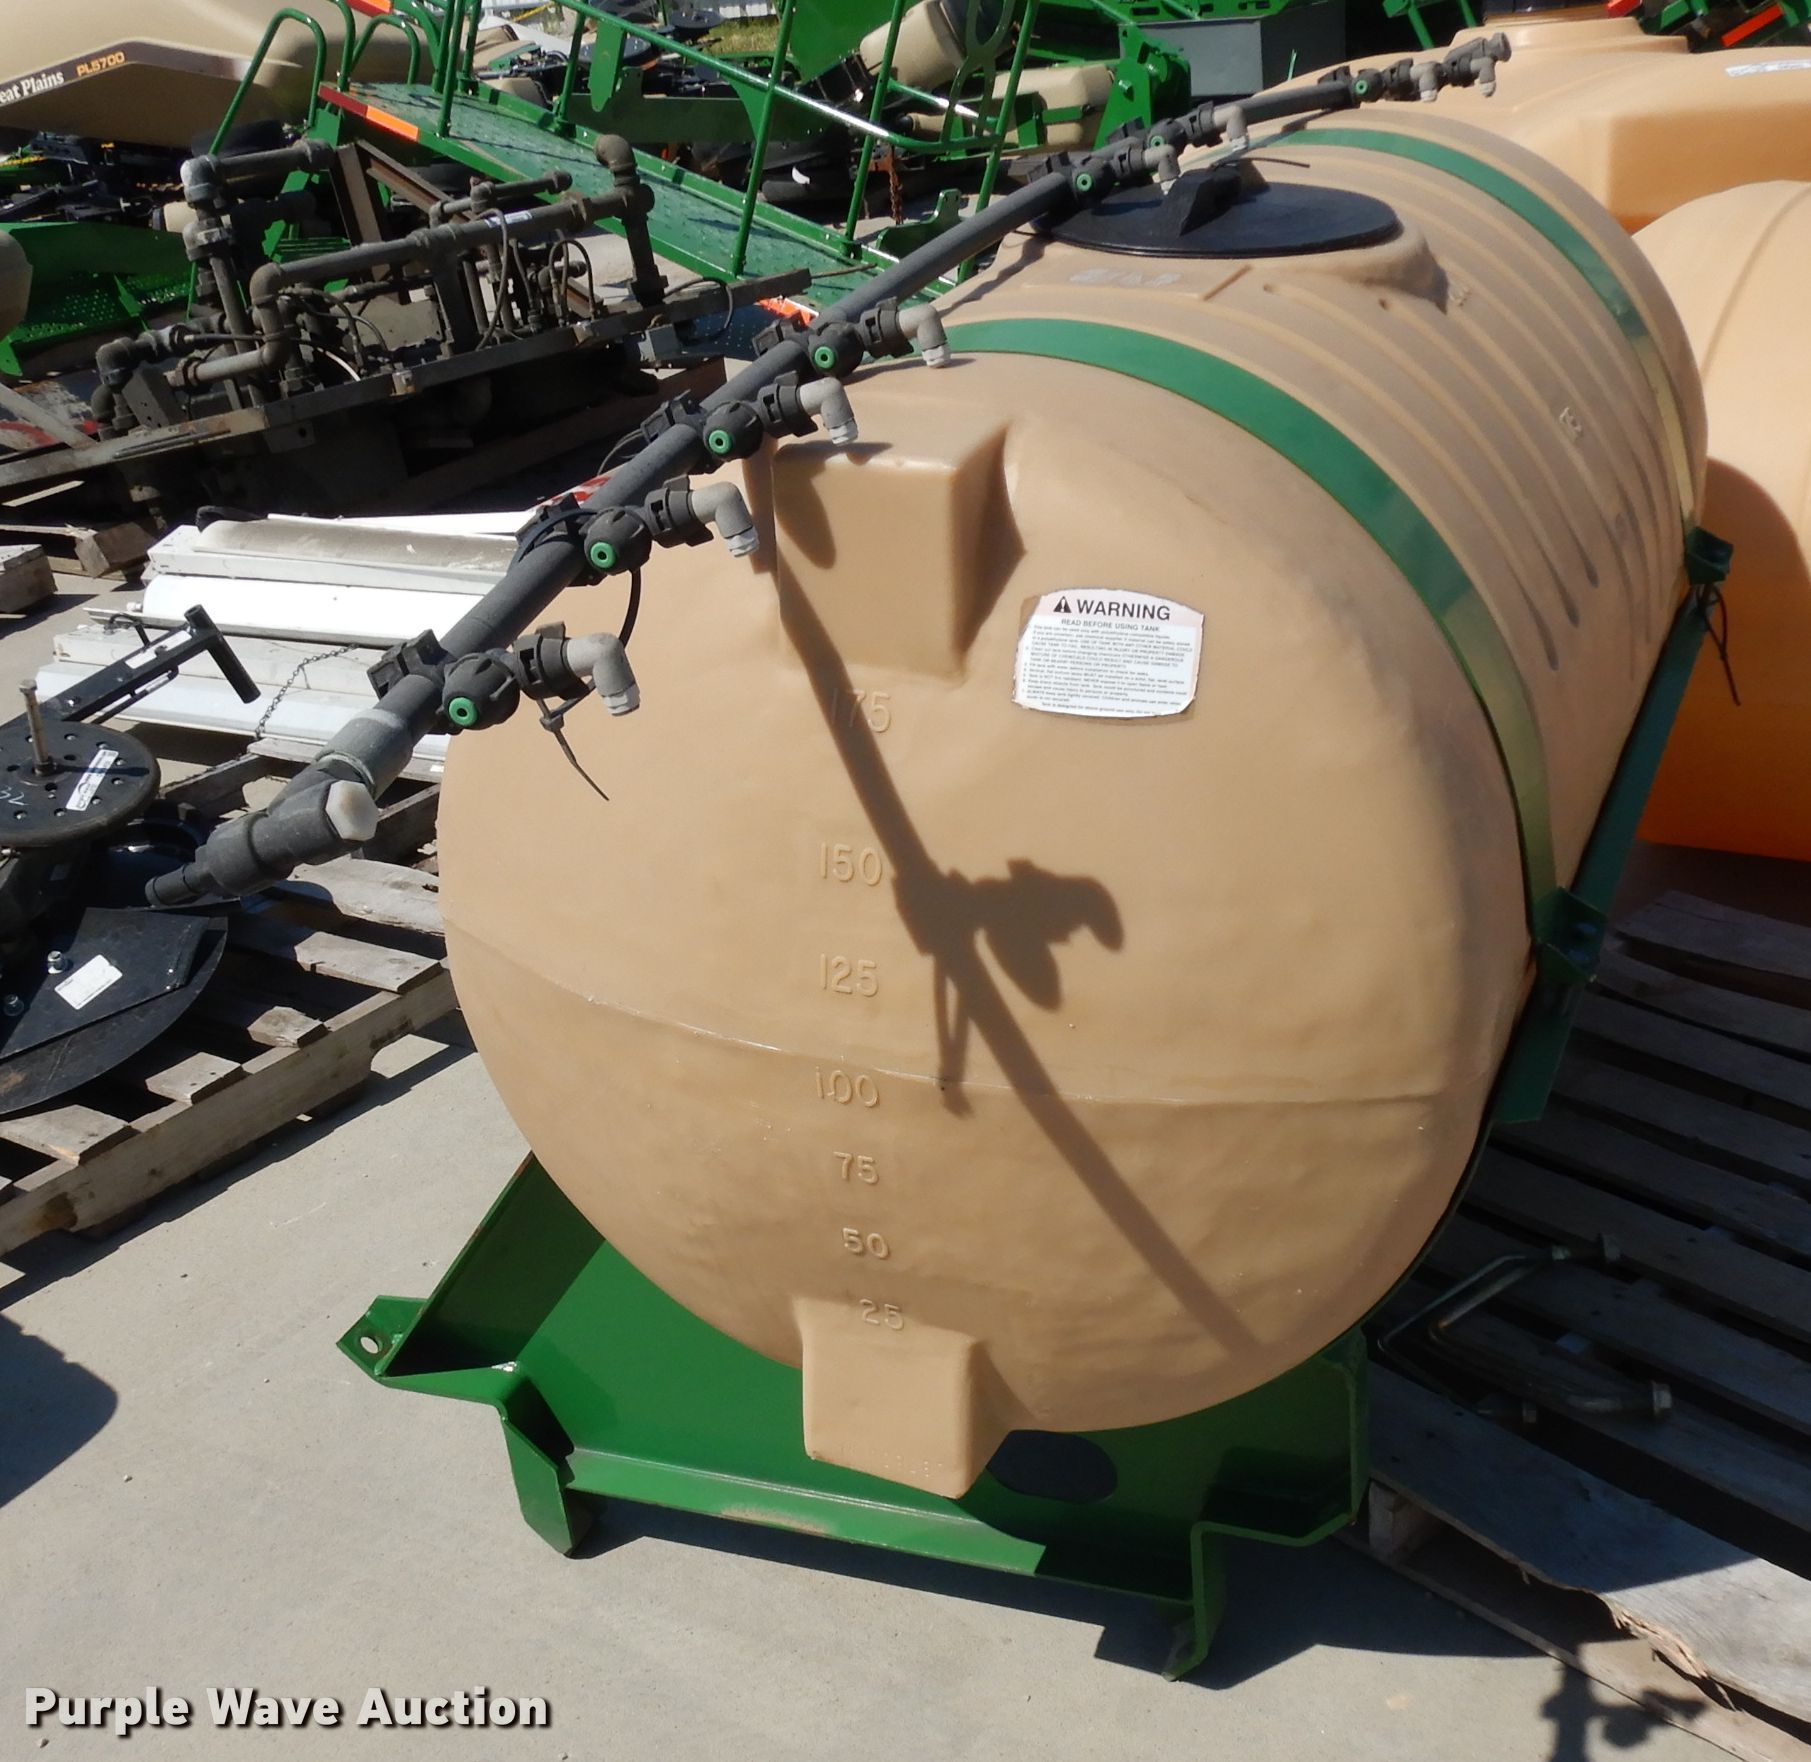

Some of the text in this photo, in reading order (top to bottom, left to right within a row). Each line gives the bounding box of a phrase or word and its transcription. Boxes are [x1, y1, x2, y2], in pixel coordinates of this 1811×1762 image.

[20, 72, 64, 96] Plains
[1061, 618, 1160, 632] READ BEFORE USING TANK
[1077, 599, 1170, 620] WARNING
[831, 688, 892, 732] 175
[820, 842, 883, 886] 150
[820, 953, 879, 997] 125
[815, 1066, 880, 1108] 100
[833, 1151, 879, 1184] 75
[842, 1227, 889, 1259] 50
[859, 1298, 905, 1331] 25
